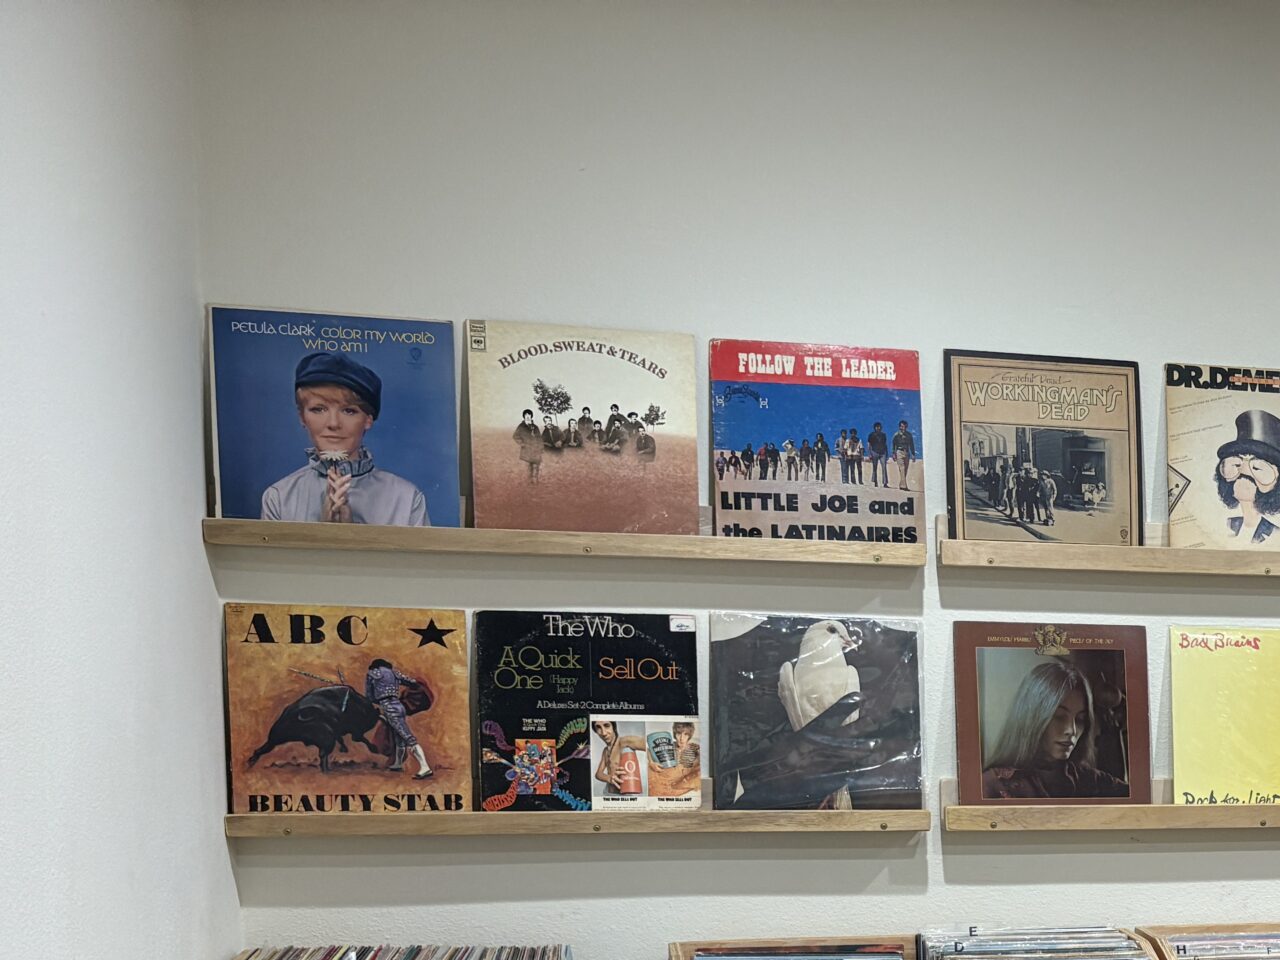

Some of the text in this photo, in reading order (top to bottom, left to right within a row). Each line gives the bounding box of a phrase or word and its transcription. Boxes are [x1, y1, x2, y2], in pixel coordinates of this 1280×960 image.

[553, 340, 606, 354] SWEAT
[607, 346, 618, 357] &
[619, 348, 668, 379] TEARS
[738, 353, 896, 381] FOLLOW THE LEADER
[965, 380, 1122, 413] WORKINGMAN'S
[1038, 402, 1090, 421] DEAD
[721, 491, 914, 515] LITTLE JOE and
[722, 524, 917, 543] the LATINAIRES
[543, 614, 635, 638] The Who
[498, 646, 583, 669] A Quick
[494, 667, 544, 689] One
[599, 657, 679, 681] Sell Out
[248, 793, 463, 812] BEAUTY STAB
[969, 926, 978, 936] E
[954, 941, 964, 953] D
[1176, 945, 1187, 955] H
